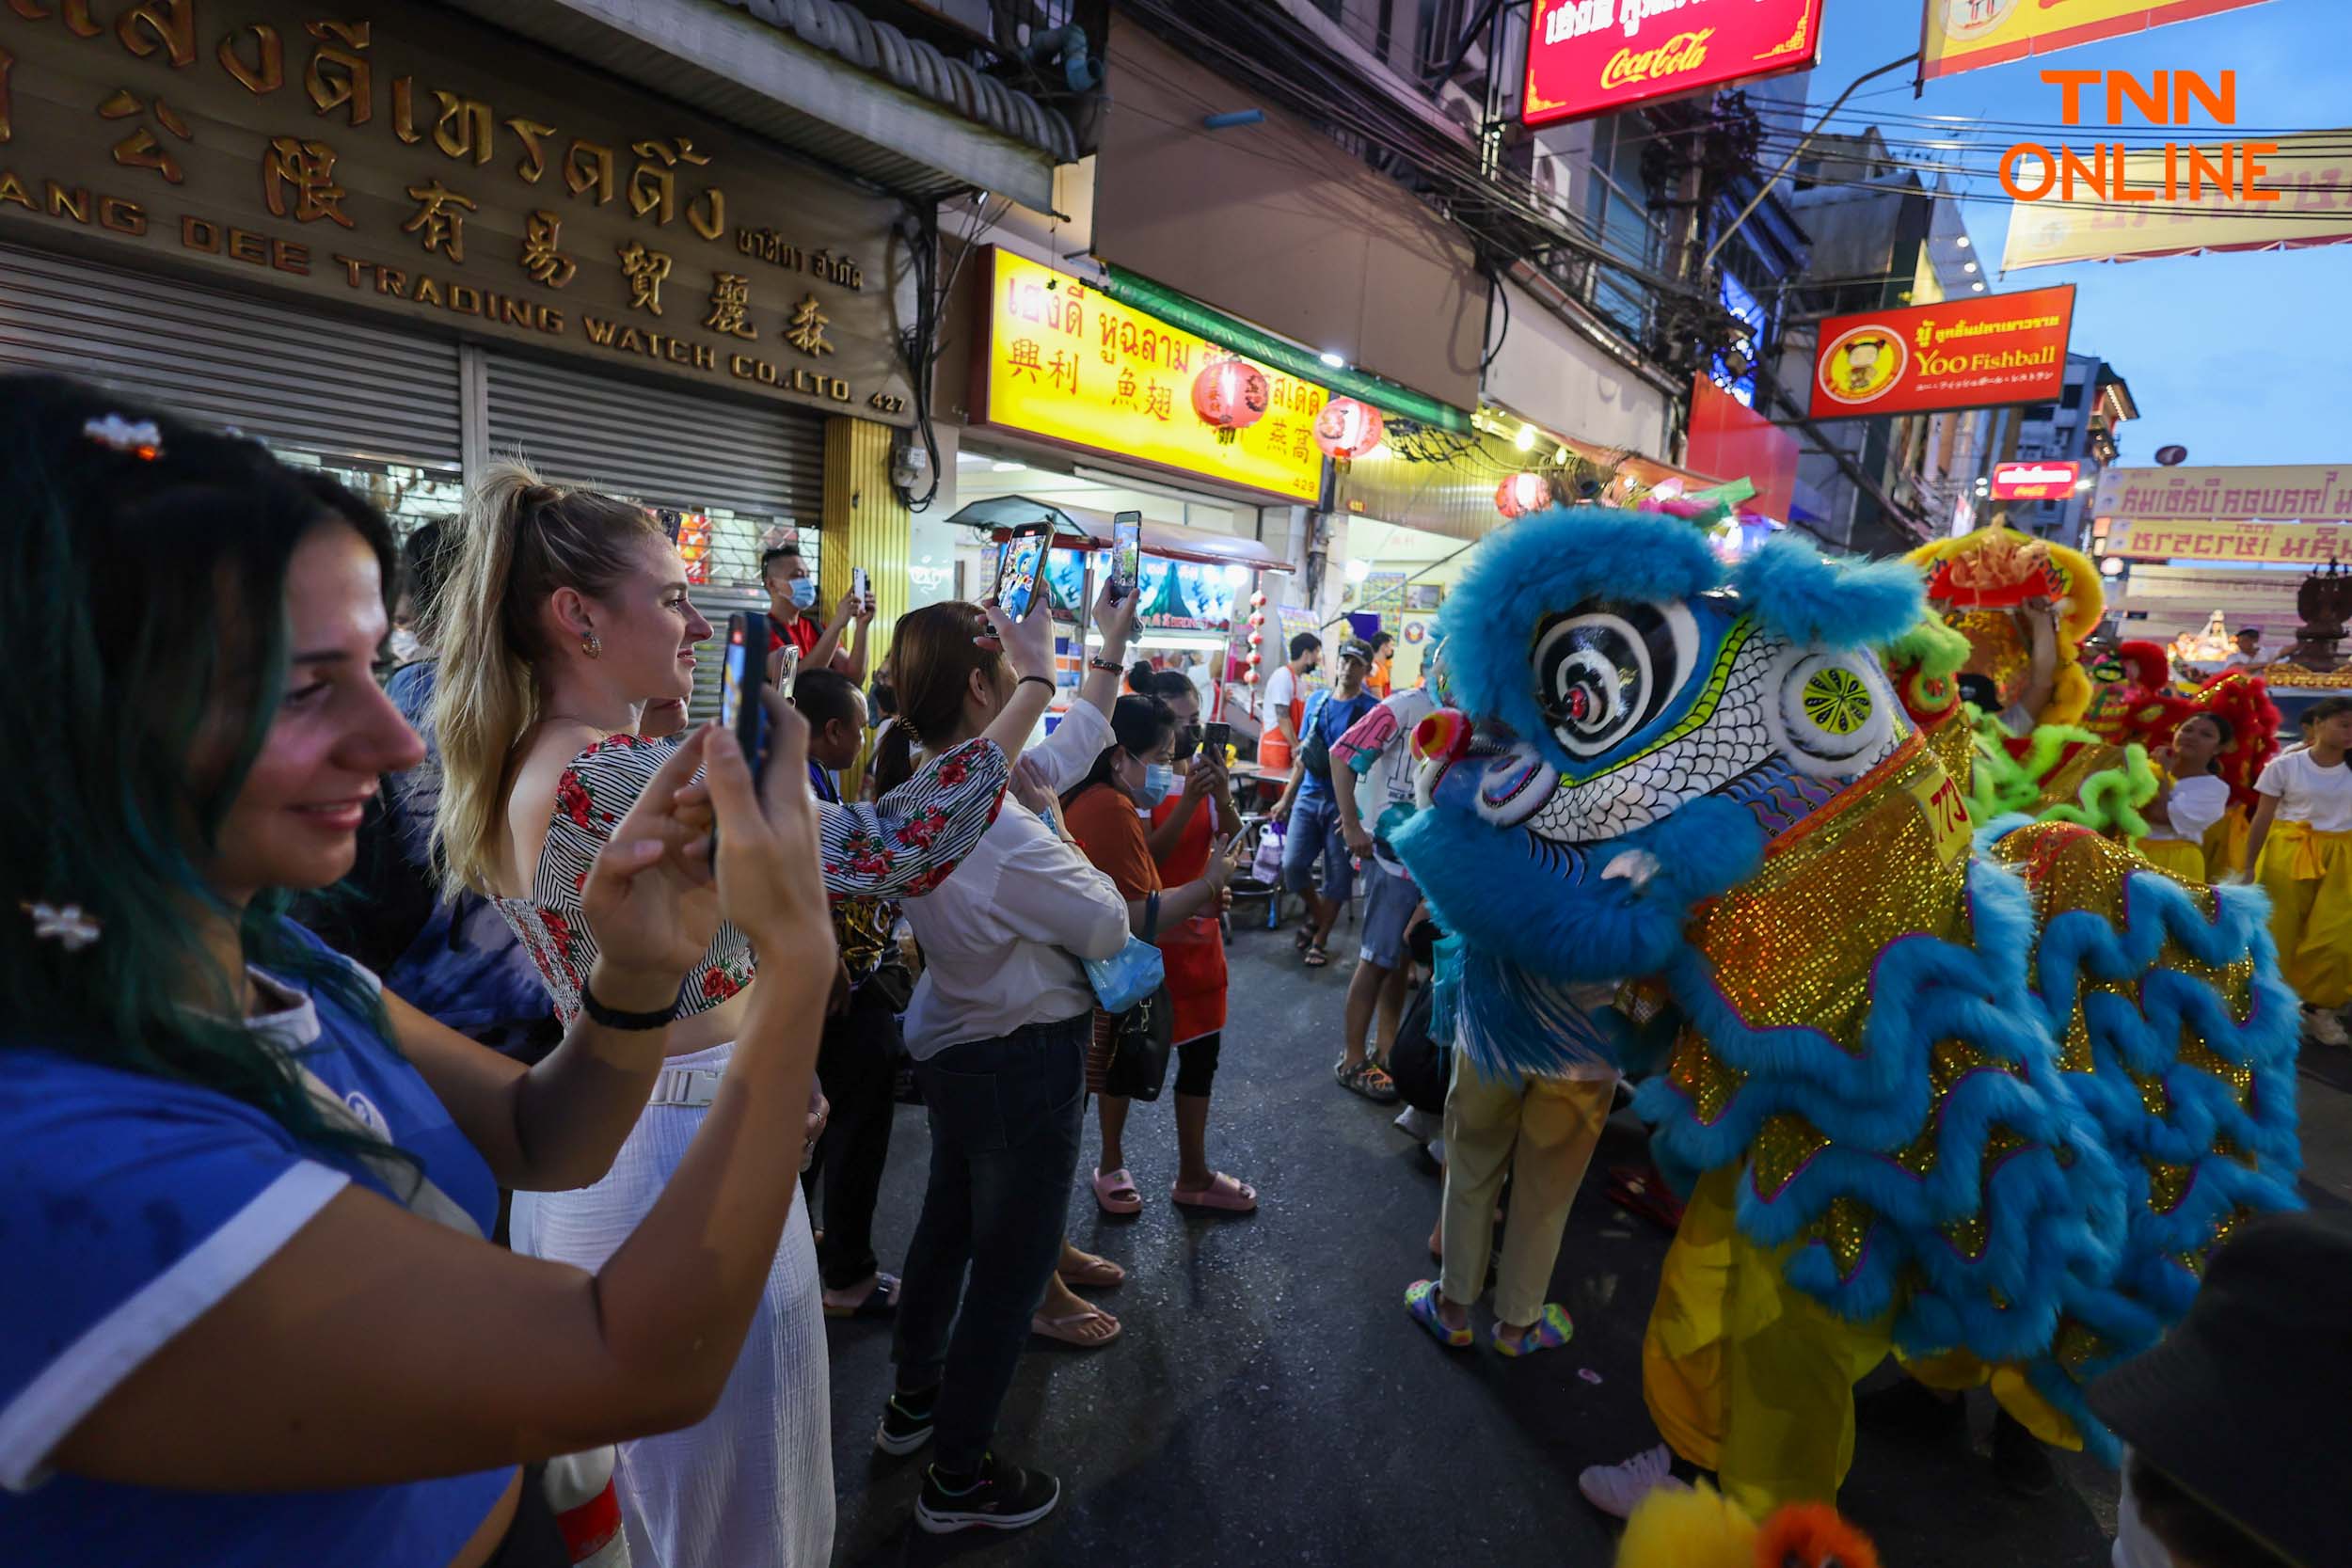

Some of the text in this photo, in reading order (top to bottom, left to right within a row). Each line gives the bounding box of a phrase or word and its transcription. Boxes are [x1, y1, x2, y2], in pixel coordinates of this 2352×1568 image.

[1600, 27, 1716, 90] Coca-Cola
[181, 214, 310, 276] DEE
[332, 252, 564, 337] TRADING
[583, 314, 715, 371] WATCH
[872, 391, 906, 413] 427
[1009, 277, 1085, 338] เฮงดี
[1098, 312, 1190, 373] หูฉลาม
[1915, 346, 2056, 376] Yoo Fishball
[1008, 339, 1078, 396] 興利
[1111, 367, 1173, 421] 魚翅
[1266, 417, 1312, 465] 燕窩
[1293, 479, 1315, 493] 429
